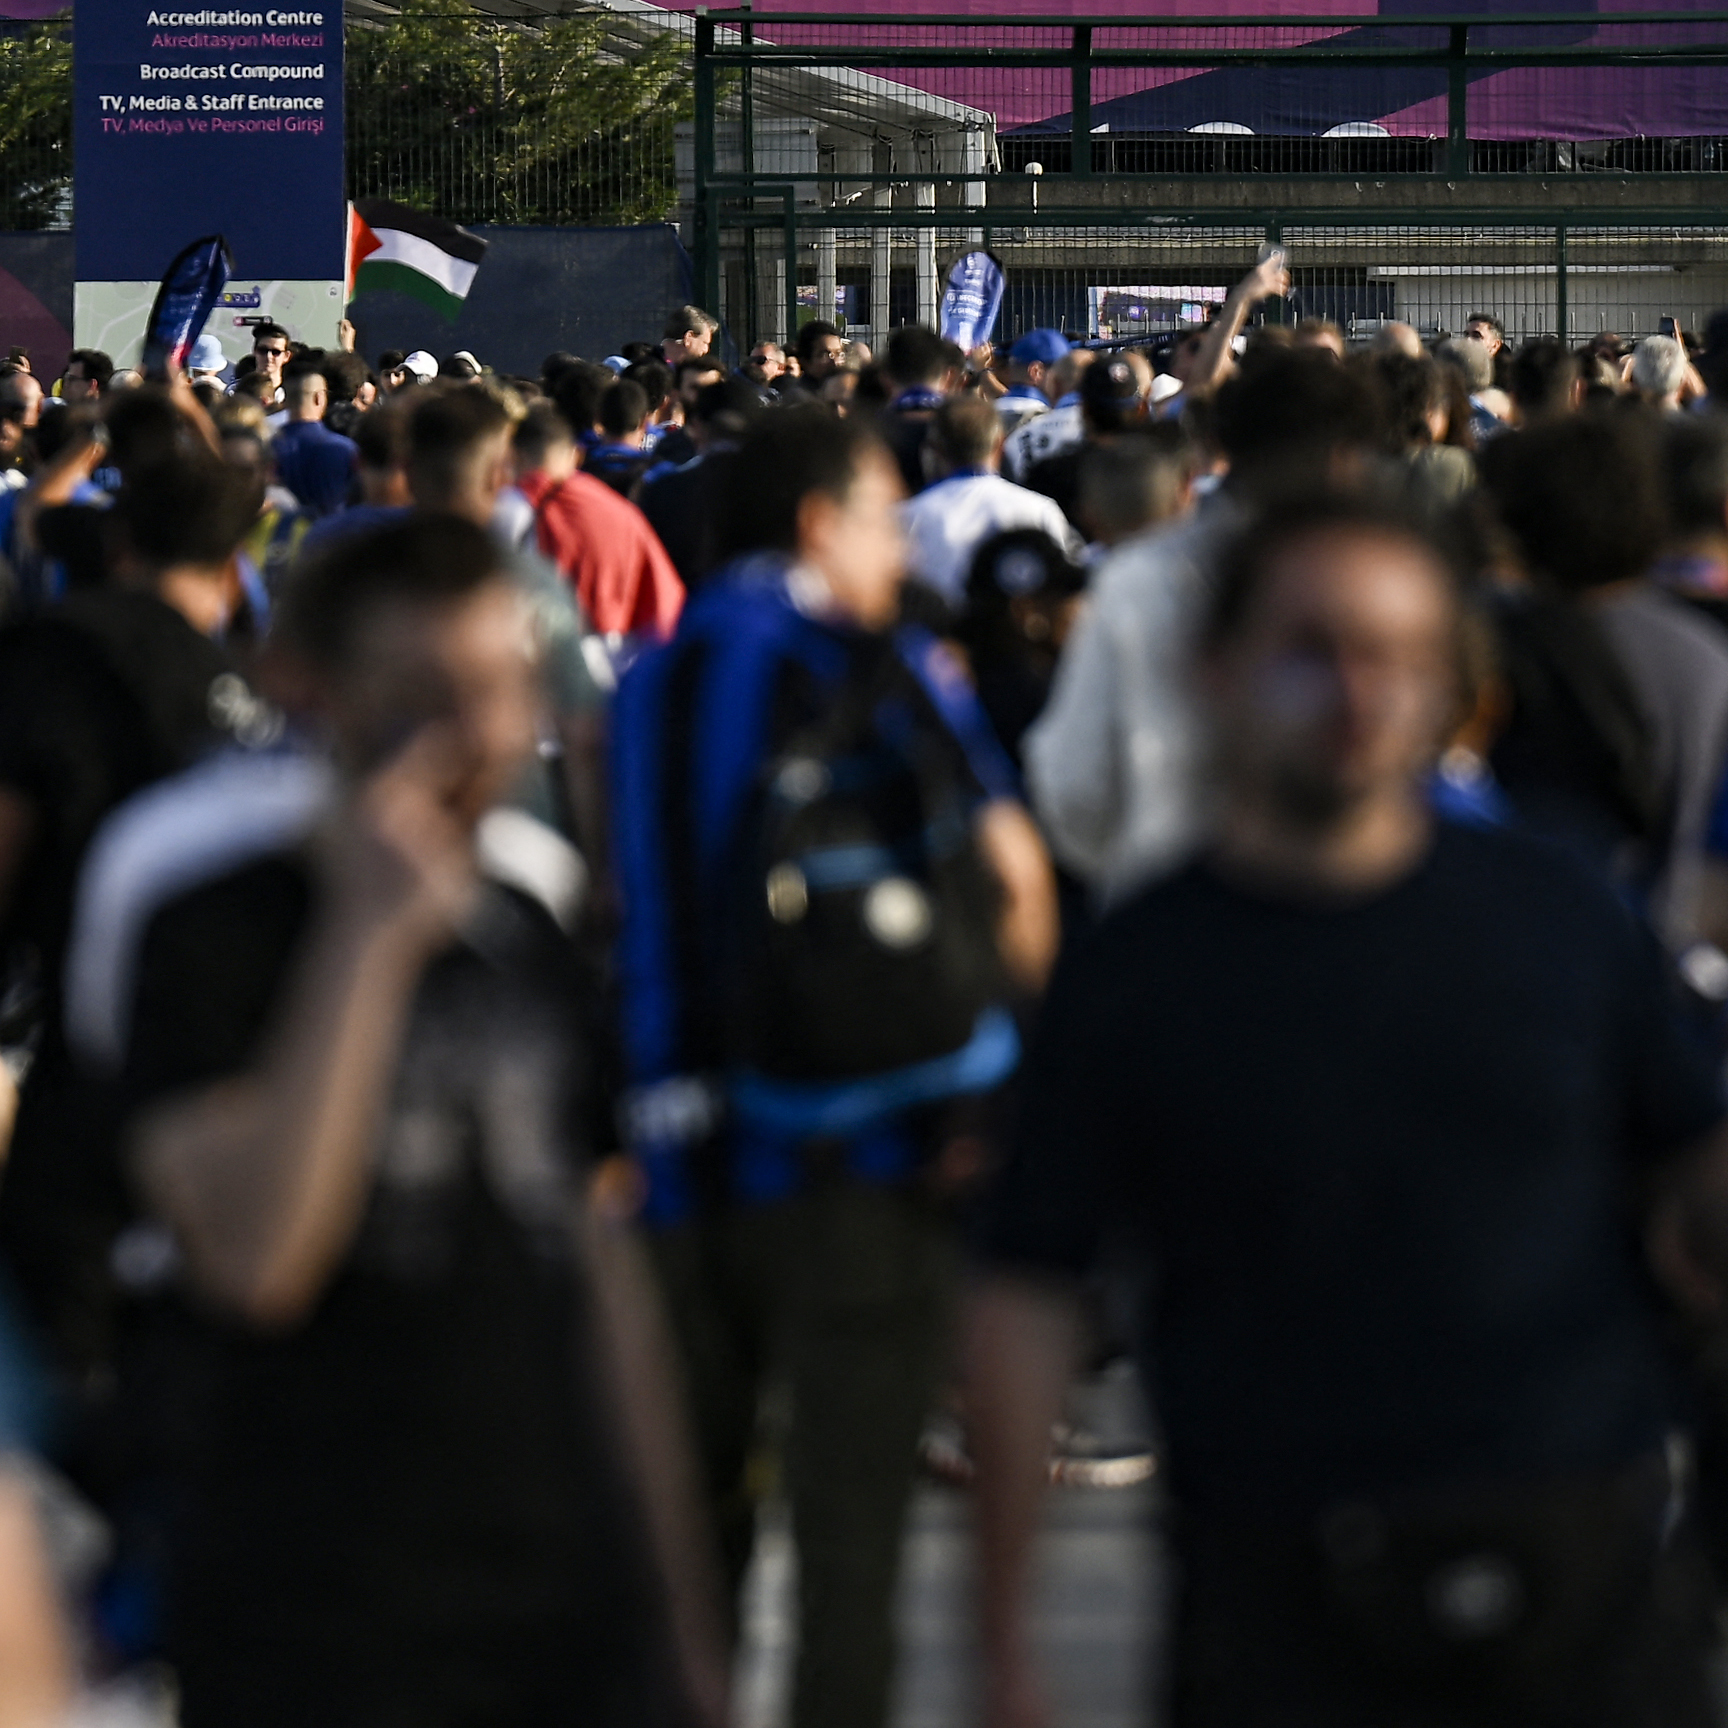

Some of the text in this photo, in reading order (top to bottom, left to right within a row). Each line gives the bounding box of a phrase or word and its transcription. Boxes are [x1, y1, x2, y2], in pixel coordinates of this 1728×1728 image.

[146, 10, 323, 27] Accreditation Centre
[151, 33, 324, 51] Akreditasyon Merkezi
[139, 63, 324, 82] Broadcast Compound
[99, 95, 324, 114] TV, Media & Staff Entrance
[130, 117, 183, 135] Medya
[187, 118, 208, 132] Ve
[210, 117, 281, 132] Personel
